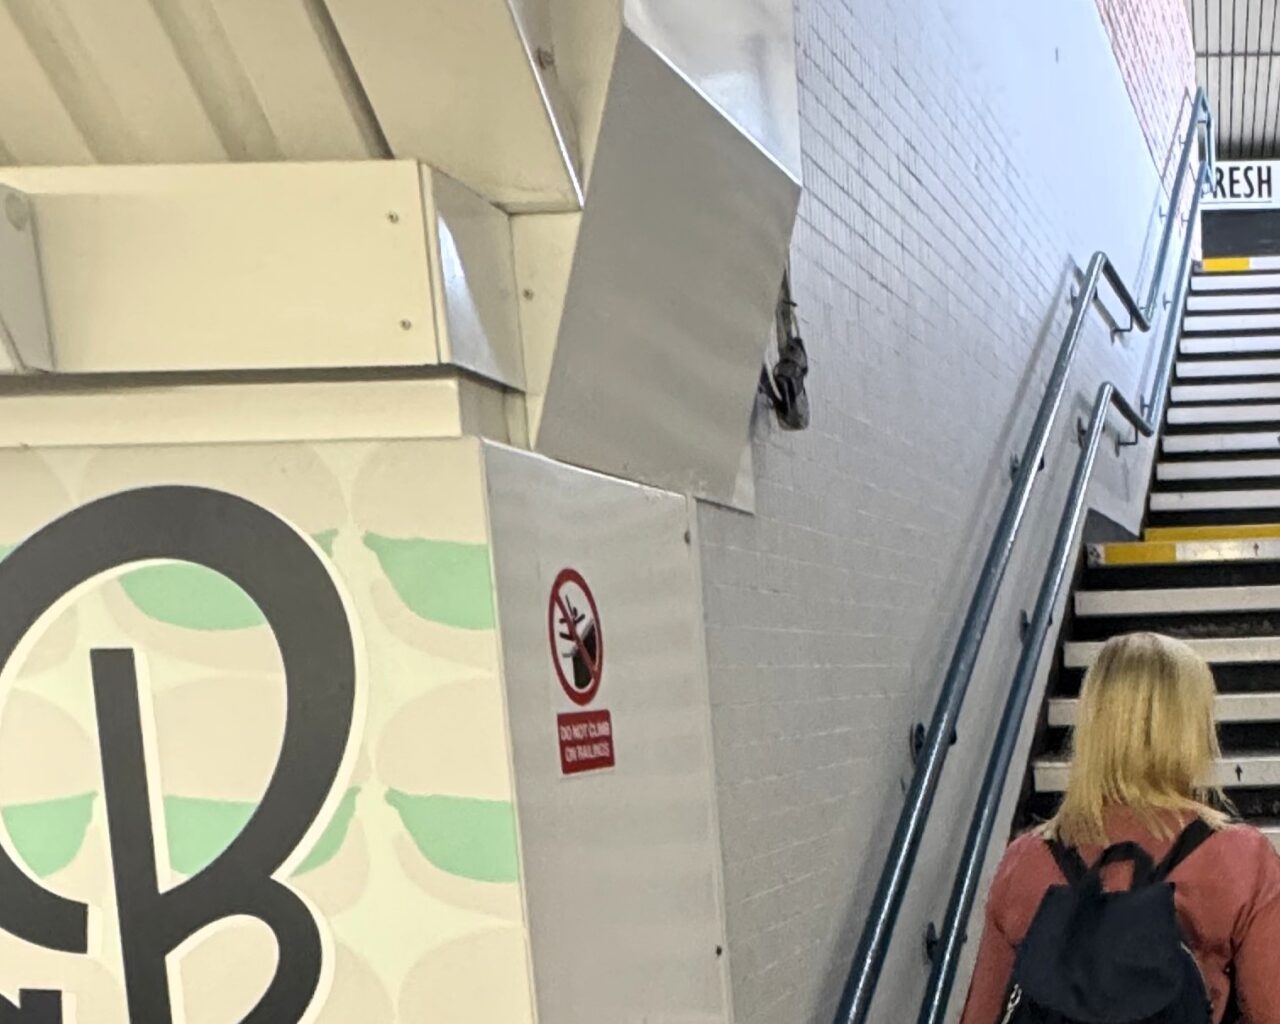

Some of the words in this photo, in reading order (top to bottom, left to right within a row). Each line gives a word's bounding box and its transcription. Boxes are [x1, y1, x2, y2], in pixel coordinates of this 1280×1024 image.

[1201, 166, 1272, 199] RESH
[560, 725, 572, 741] DO
[572, 723, 588, 740] NOT
[565, 746, 577, 762] ON
